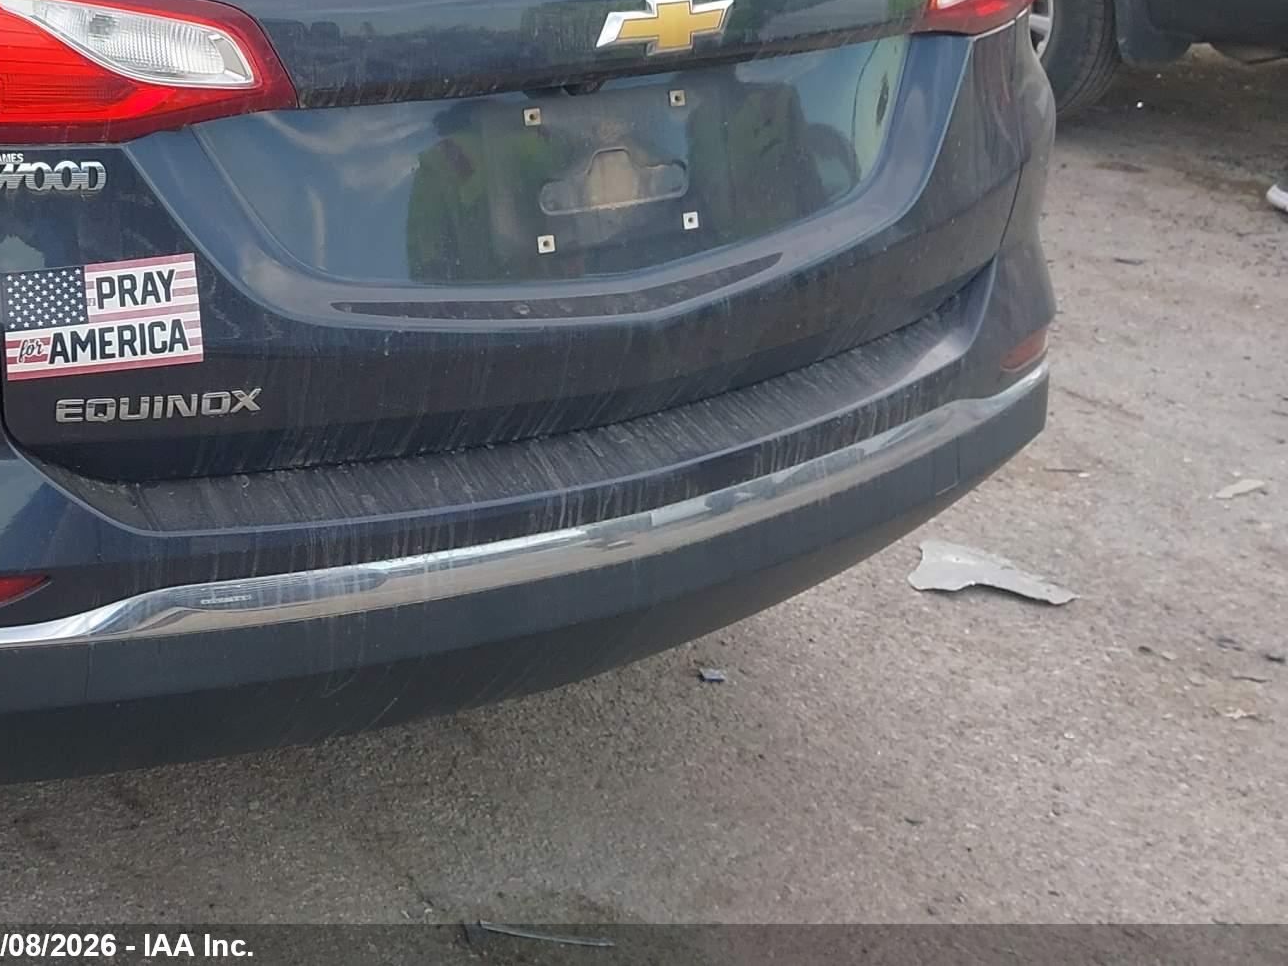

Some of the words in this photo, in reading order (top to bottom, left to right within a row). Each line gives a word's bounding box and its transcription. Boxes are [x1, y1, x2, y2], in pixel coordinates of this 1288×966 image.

[96, 269, 176, 310] PRAY
[17, 337, 45, 364] for
[48, 318, 189, 365] AMERICA
[55, 387, 262, 423] EQUINOX
